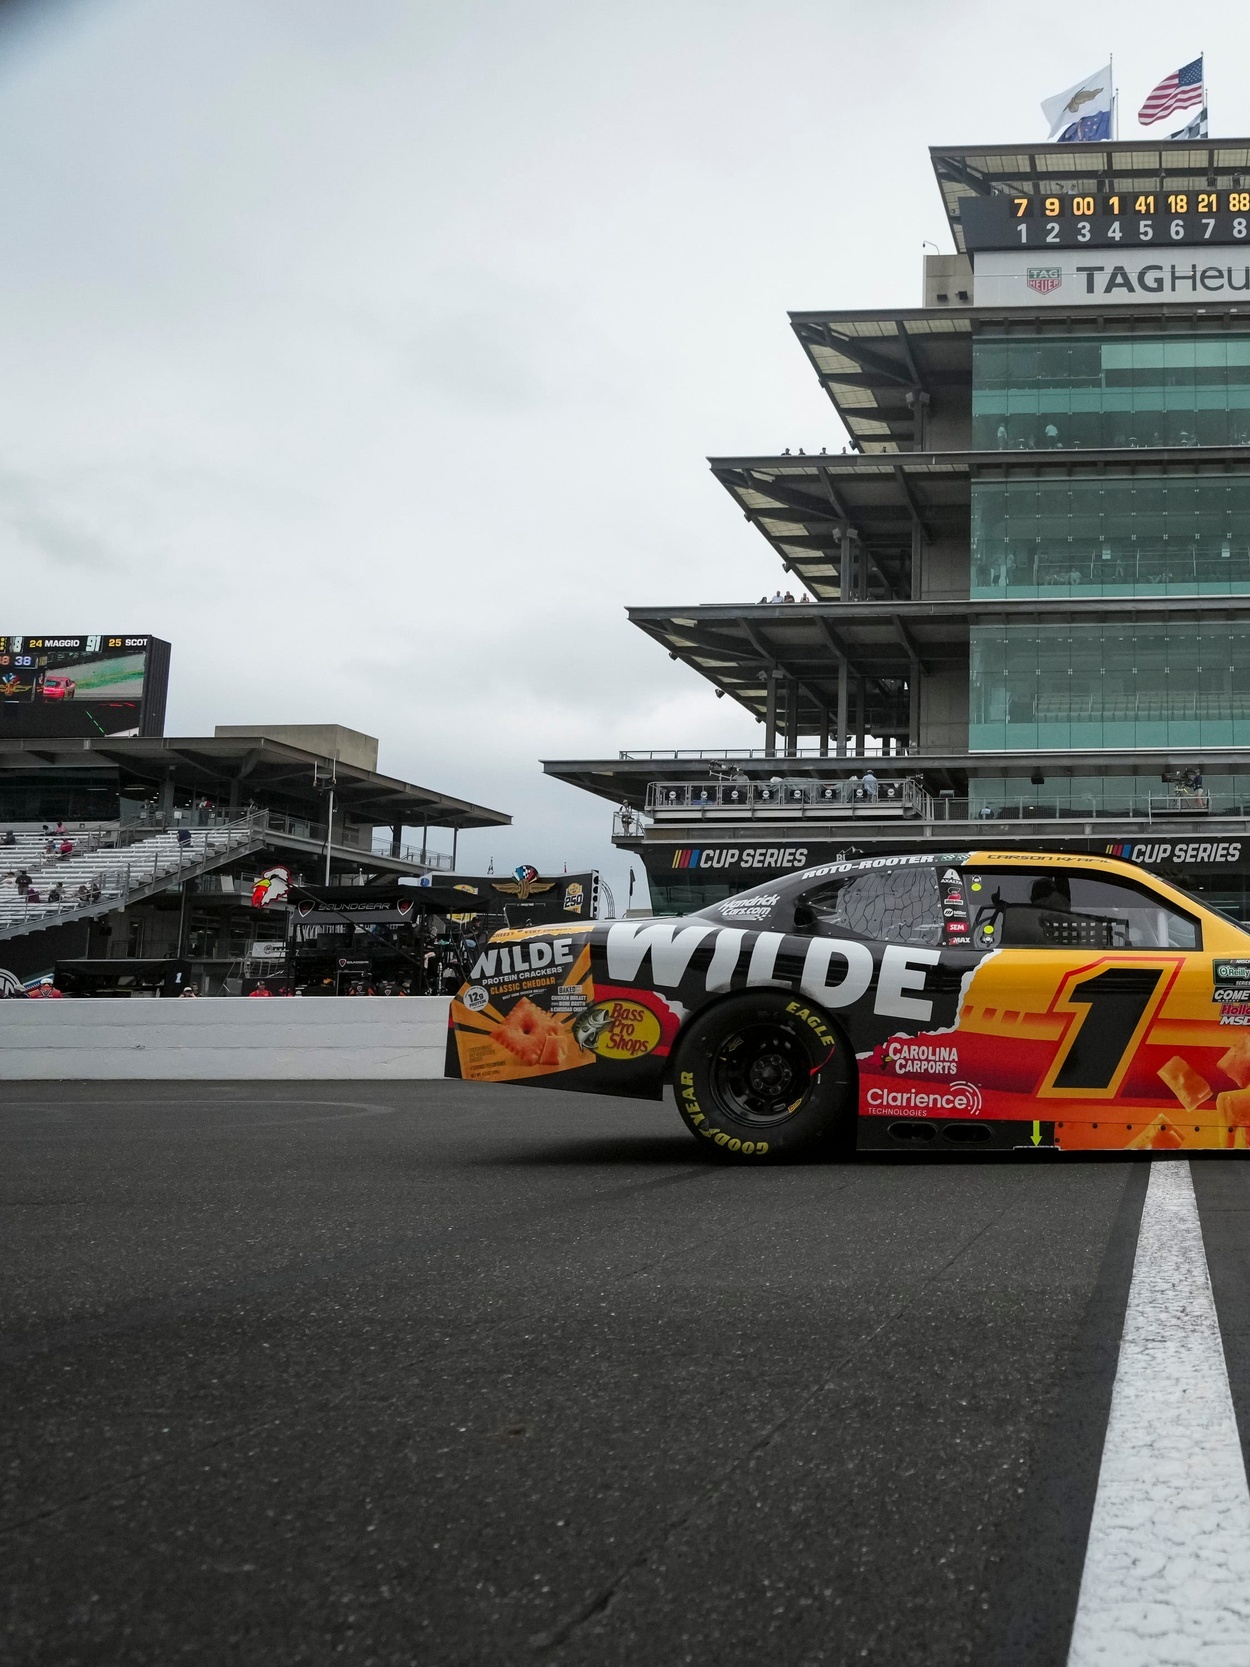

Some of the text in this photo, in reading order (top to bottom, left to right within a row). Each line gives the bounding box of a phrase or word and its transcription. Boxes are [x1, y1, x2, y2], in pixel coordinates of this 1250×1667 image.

[1014, 199, 1029, 217] 7
[1045, 198, 1060, 216] 9
[1073, 197, 1094, 215] 00
[1109, 197, 1120, 214] 1
[1135, 196, 1155, 214] 41
[1168, 195, 1188, 213] 18
[1198, 194, 1218, 212] 21
[1229, 193, 1250, 211] 88
[1017, 224, 1027, 243] 1
[1046, 223, 1060, 242] 2
[1077, 222, 1091, 242] 3
[1107, 221, 1122, 241] 4
[1139, 221, 1153, 240] 5
[1170, 220, 1184, 240] 6
[1201, 219, 1215, 239] 7
[1232, 218, 1247, 238] 8
[1030, 269, 1059, 278] TAG
[1029, 280, 1060, 292] HEUER
[29, 639, 80, 648] 24 MAGGIO
[109, 638, 148, 647] 25 SCOT
[0, 656, 32, 666] 8 38
[700, 848, 808, 868] CUP SERIES
[1131, 843, 1242, 863] CUP SERIES
[802, 855, 935, 879] ROTO-ROOTER
[318, 902, 391, 911] SOUNDGEAR
[564, 894, 584, 909] 250
[718, 893, 781, 912] Hendrick
[722, 907, 772, 915] Cars.com
[482, 967, 563, 986] PROTEIN CRACKERS
[607, 922, 941, 1022] WILDE
[490, 976, 556, 995] CLASSIC CHEDDAR
[468, 992, 484, 1003] 12g
[610, 1002, 645, 1022] Bass
[607, 1018, 635, 1036] Pro
[785, 1001, 835, 1047] EAGLE
[1050, 966, 1166, 1090] 1
[606, 1032, 649, 1056] Shops
[888, 1042, 959, 1062] CAROLINA
[895, 1059, 957, 1075] CARPORTS
[867, 1087, 968, 1109] Clarience
[681, 1071, 769, 1155] GOODYEAR
[868, 1107, 927, 1117] TECHNOLOGIES
